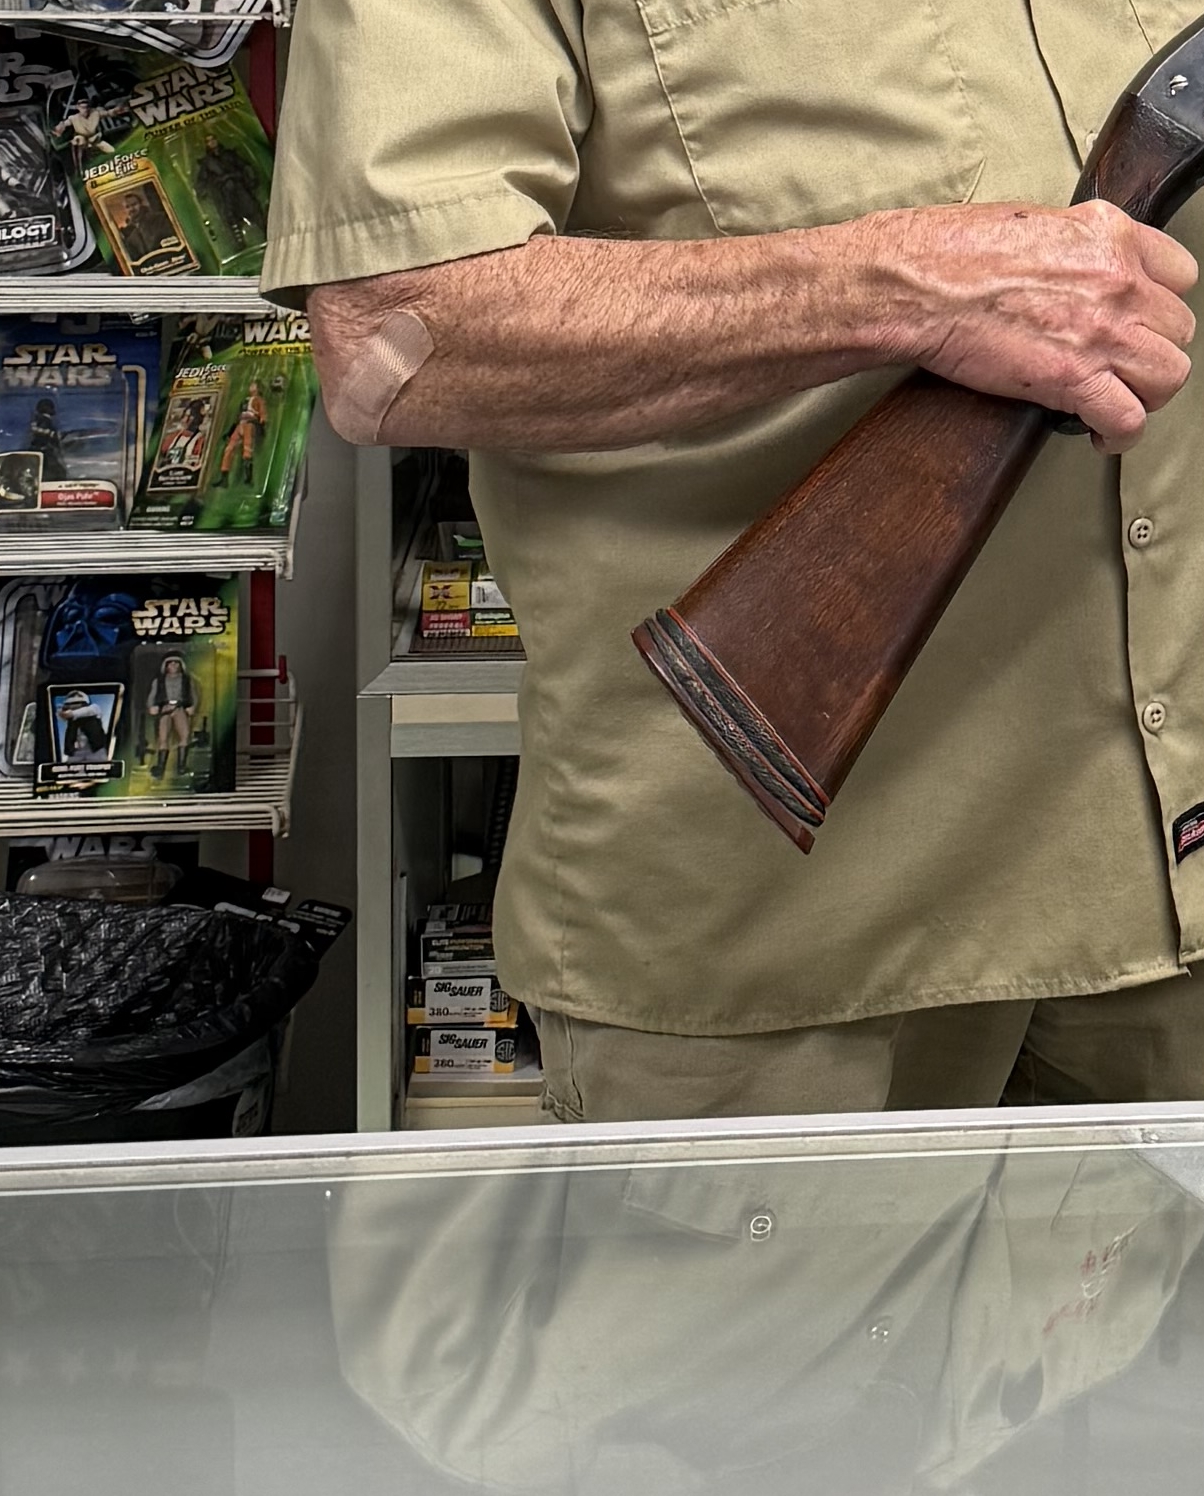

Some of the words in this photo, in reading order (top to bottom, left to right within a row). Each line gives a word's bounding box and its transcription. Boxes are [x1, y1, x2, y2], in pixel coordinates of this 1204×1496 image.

[129, 67, 233, 107] STAR
[132, 77, 235, 127] WARS
[83, 160, 115, 182] JEDI
[244, 319, 311, 346] WAR
[3, 343, 117, 365] STAR
[2, 364, 117, 388] WARS
[175, 366, 204, 379] JEDI
[132, 597, 228, 618] STAR
[131, 616, 229, 636] WARS
[434, 982, 452, 993] SIG
[449, 986, 484, 997] SAUER
[438, 1033, 457, 1045] SIG
[454, 1038, 489, 1049] SAUER
